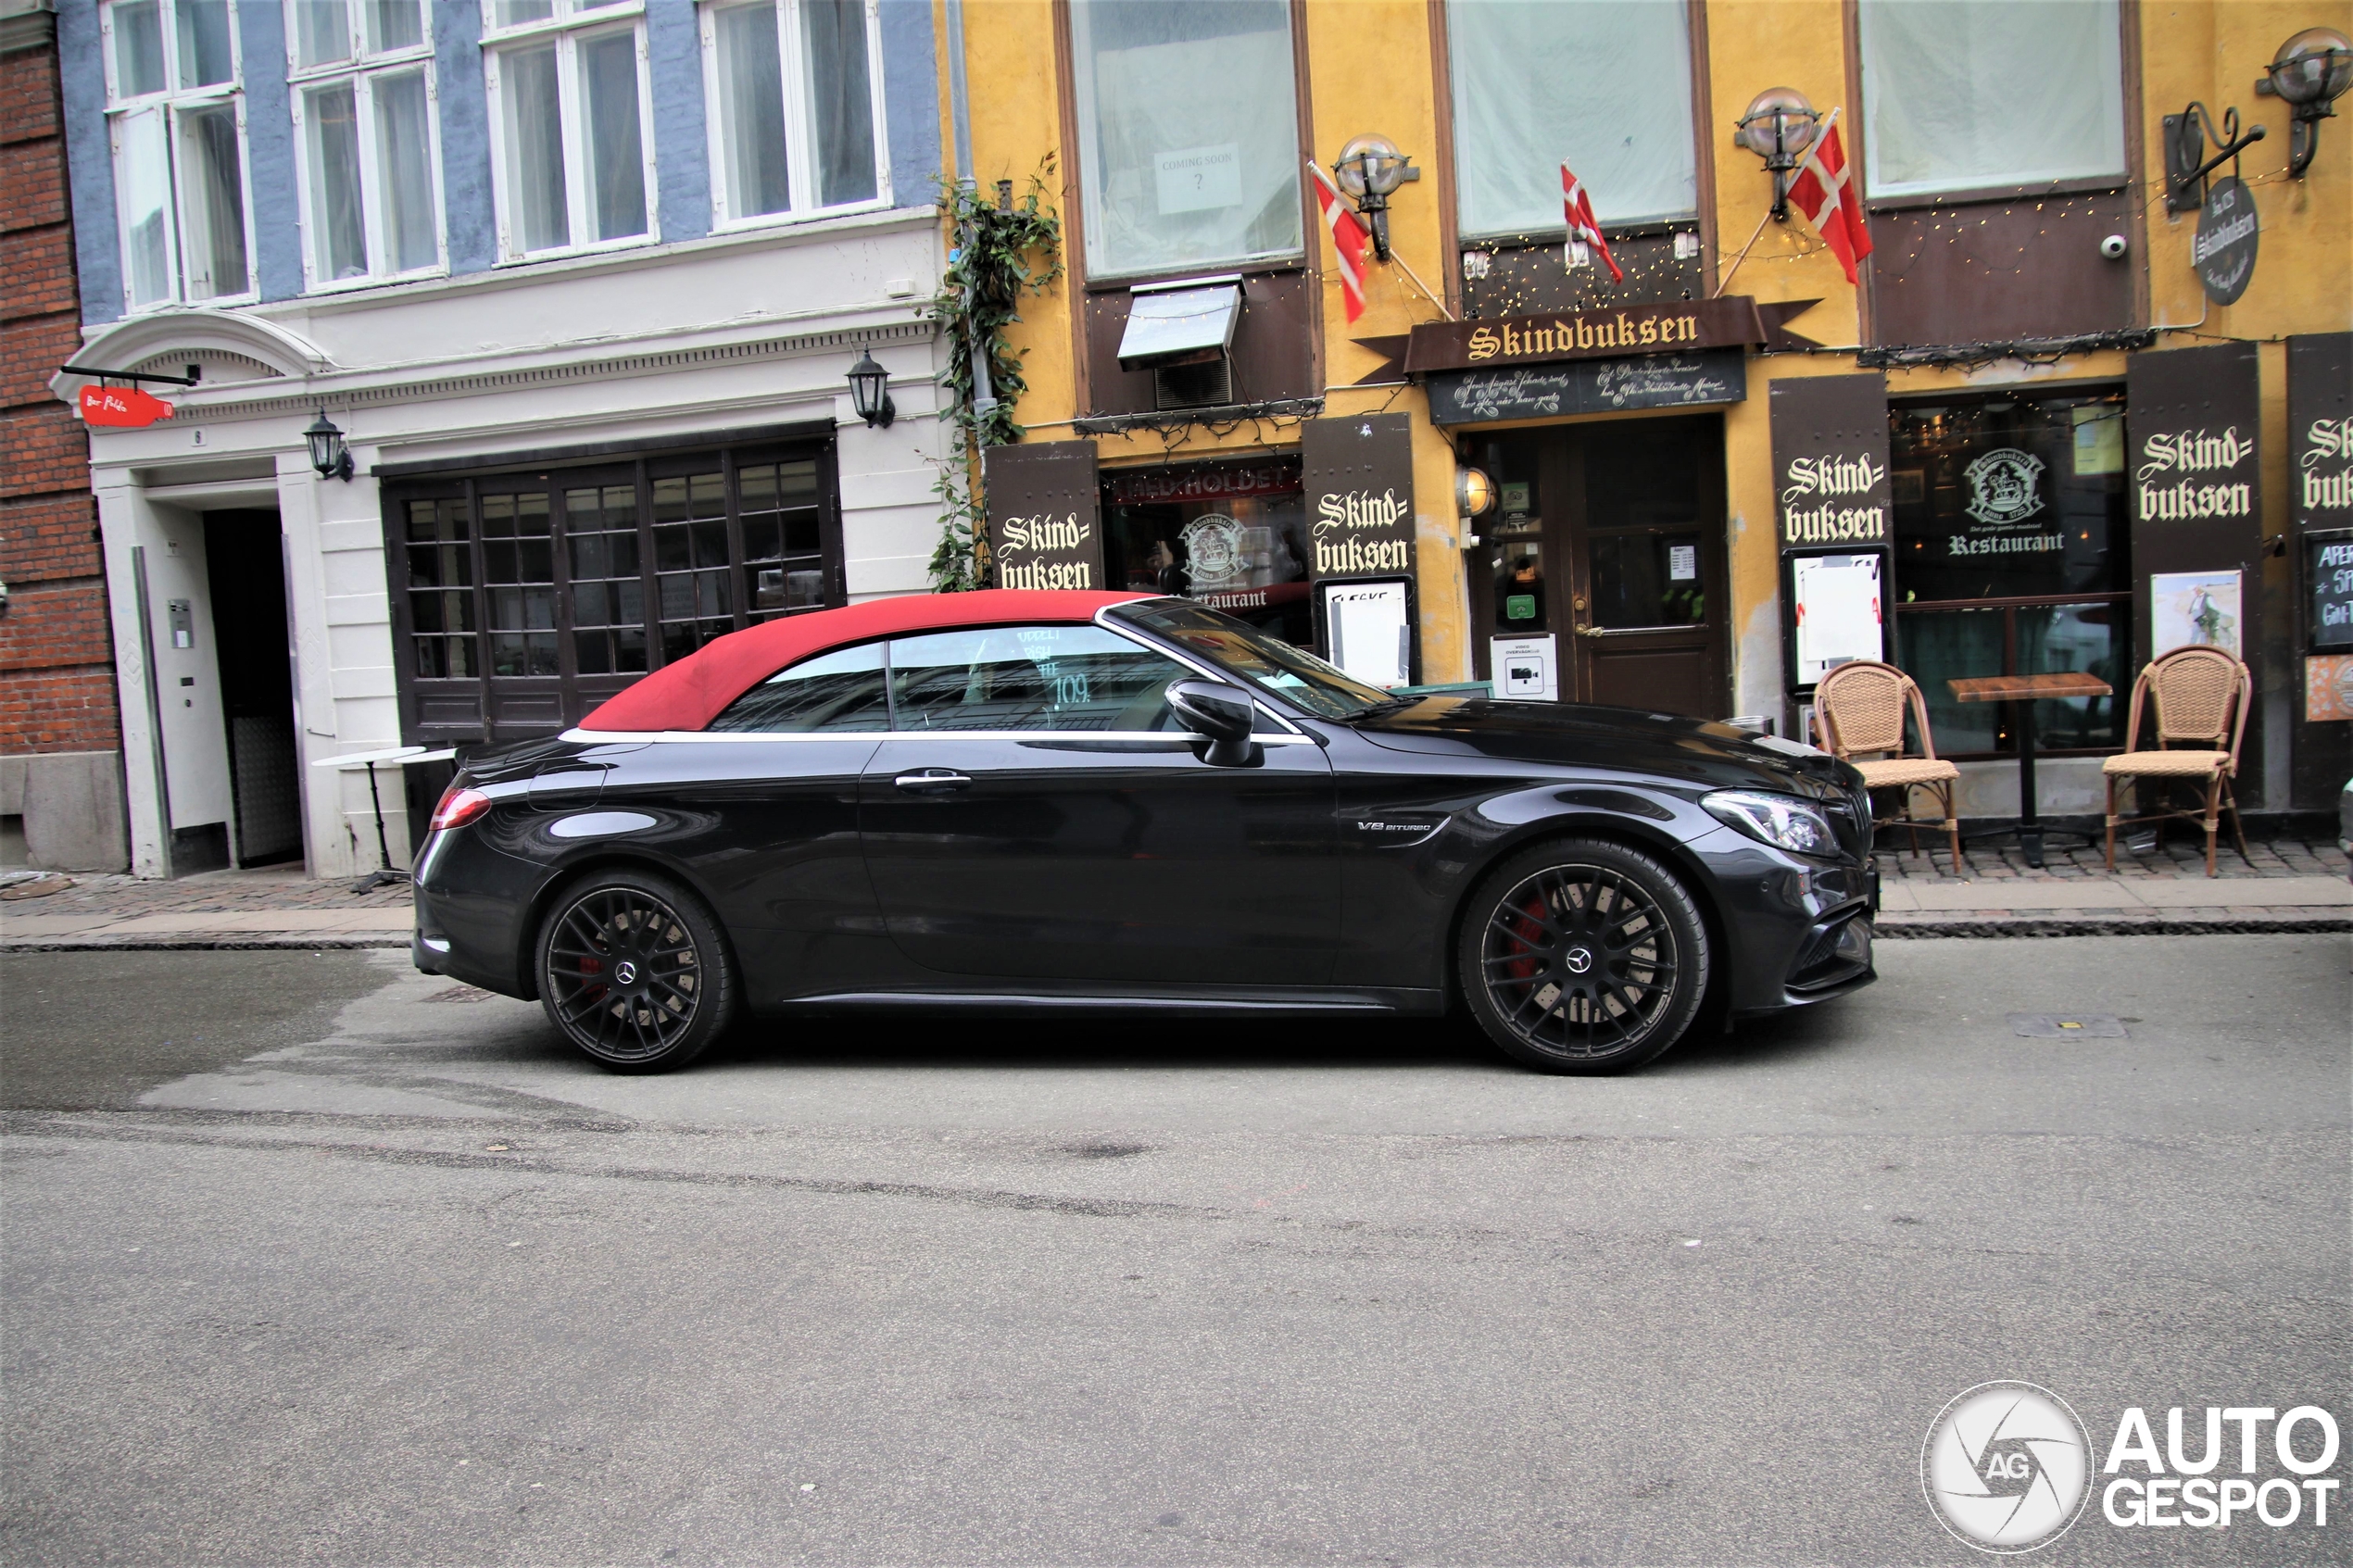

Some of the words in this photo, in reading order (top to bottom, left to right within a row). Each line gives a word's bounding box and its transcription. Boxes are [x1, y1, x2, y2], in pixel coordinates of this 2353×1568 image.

[1163, 157, 1202, 170] COMING
[1204, 153, 1232, 165] SOON
[1468, 312, 1698, 360] Skindbuksen
[86, 395, 103, 407] Bar
[1185, 470, 1287, 495] HOLDET
[2137, 477, 2251, 521] buksen
[1784, 500, 1885, 544] buksen
[1315, 533, 1409, 574] buksen
[1949, 532, 2065, 556] Restaurant
[1000, 556, 1091, 590] buksen
[1357, 822, 1385, 831] V8
